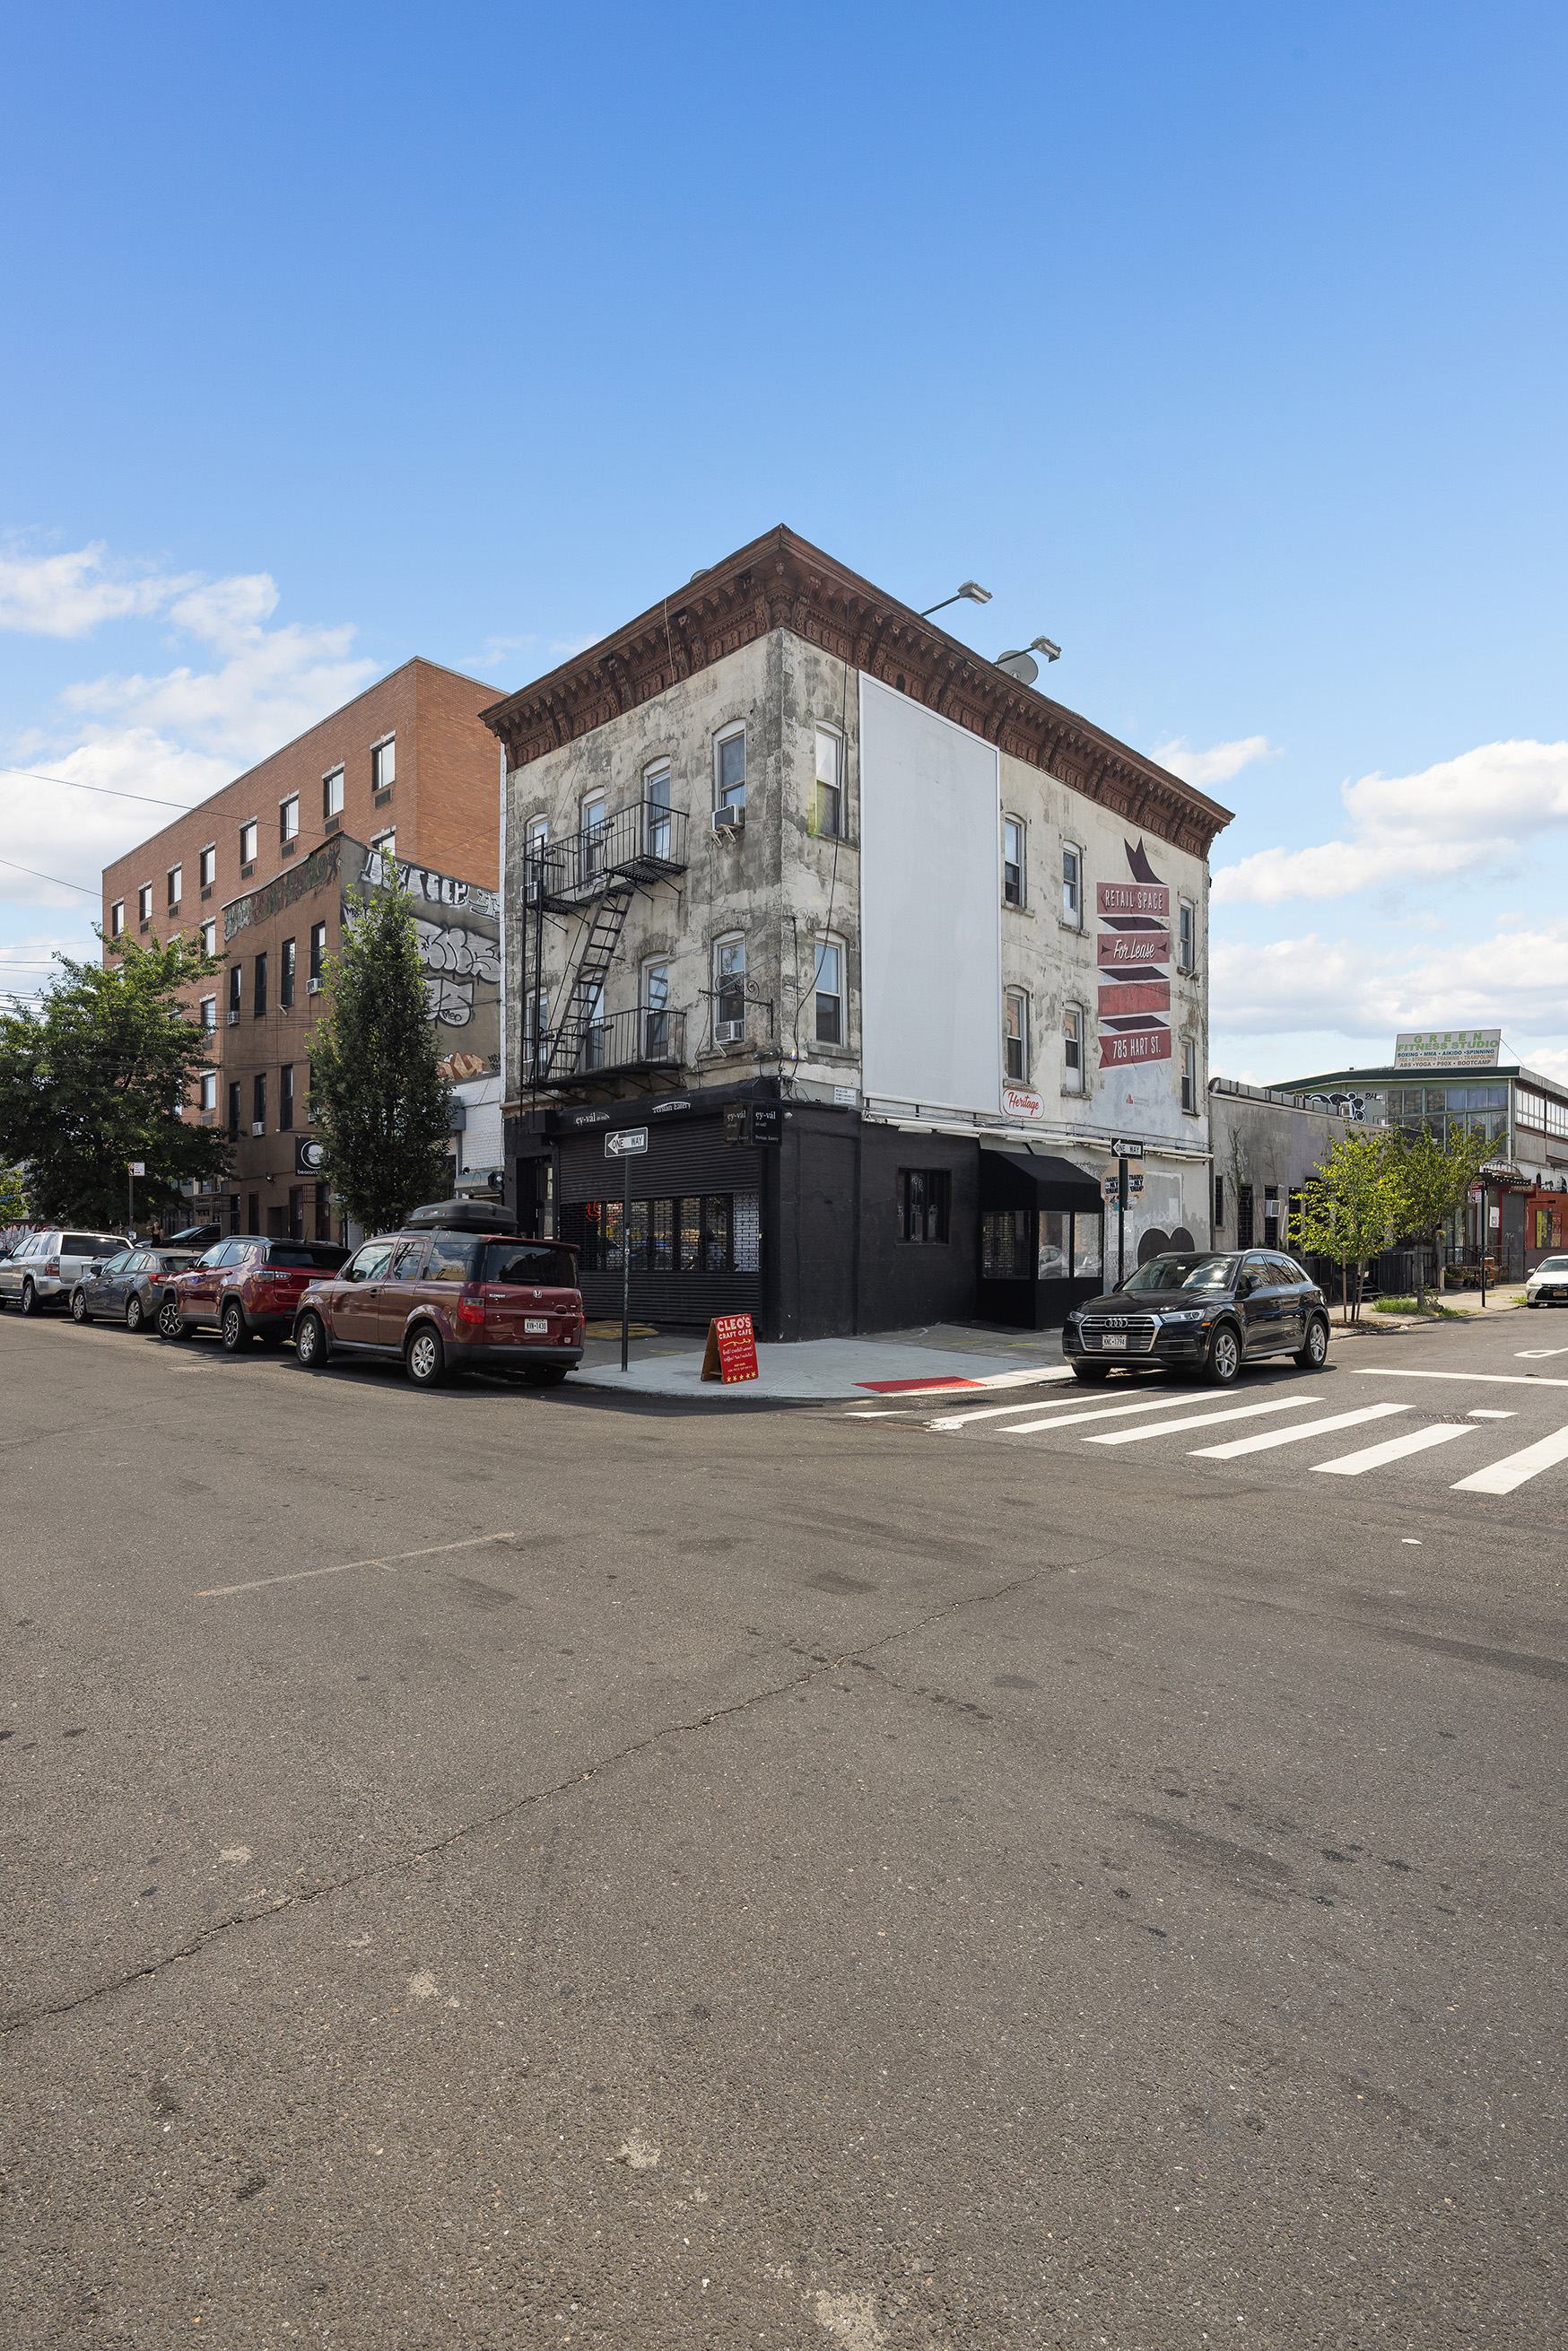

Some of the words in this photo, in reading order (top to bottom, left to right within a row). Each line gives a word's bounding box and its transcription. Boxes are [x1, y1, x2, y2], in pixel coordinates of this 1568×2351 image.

[1105, 889, 1134, 908] RETAIL
[1137, 892, 1163, 910] SPACE
[1113, 938, 1129, 959] For
[1130, 938, 1155, 959] Lease
[1414, 1032, 1483, 1043] GREEN
[1113, 1039, 1127, 1059] 785
[1130, 1037, 1148, 1057] HART
[1151, 1035, 1162, 1054] ST.
[1398, 1043, 1448, 1051] FITNESS
[1451, 1040, 1499, 1049] STUDIO
[1007, 1092, 1040, 1115] Heritage
[612, 1139, 623, 1149] ONE
[631, 1136, 642, 1146] WAY
[1116, 1144, 1126, 1153] ONE
[1130, 1145, 1140, 1154] WAY
[717, 1316, 752, 1332] CLEO'S
[719, 1331, 736, 1340] CRAFT
[737, 1328, 753, 1337] CAFE
